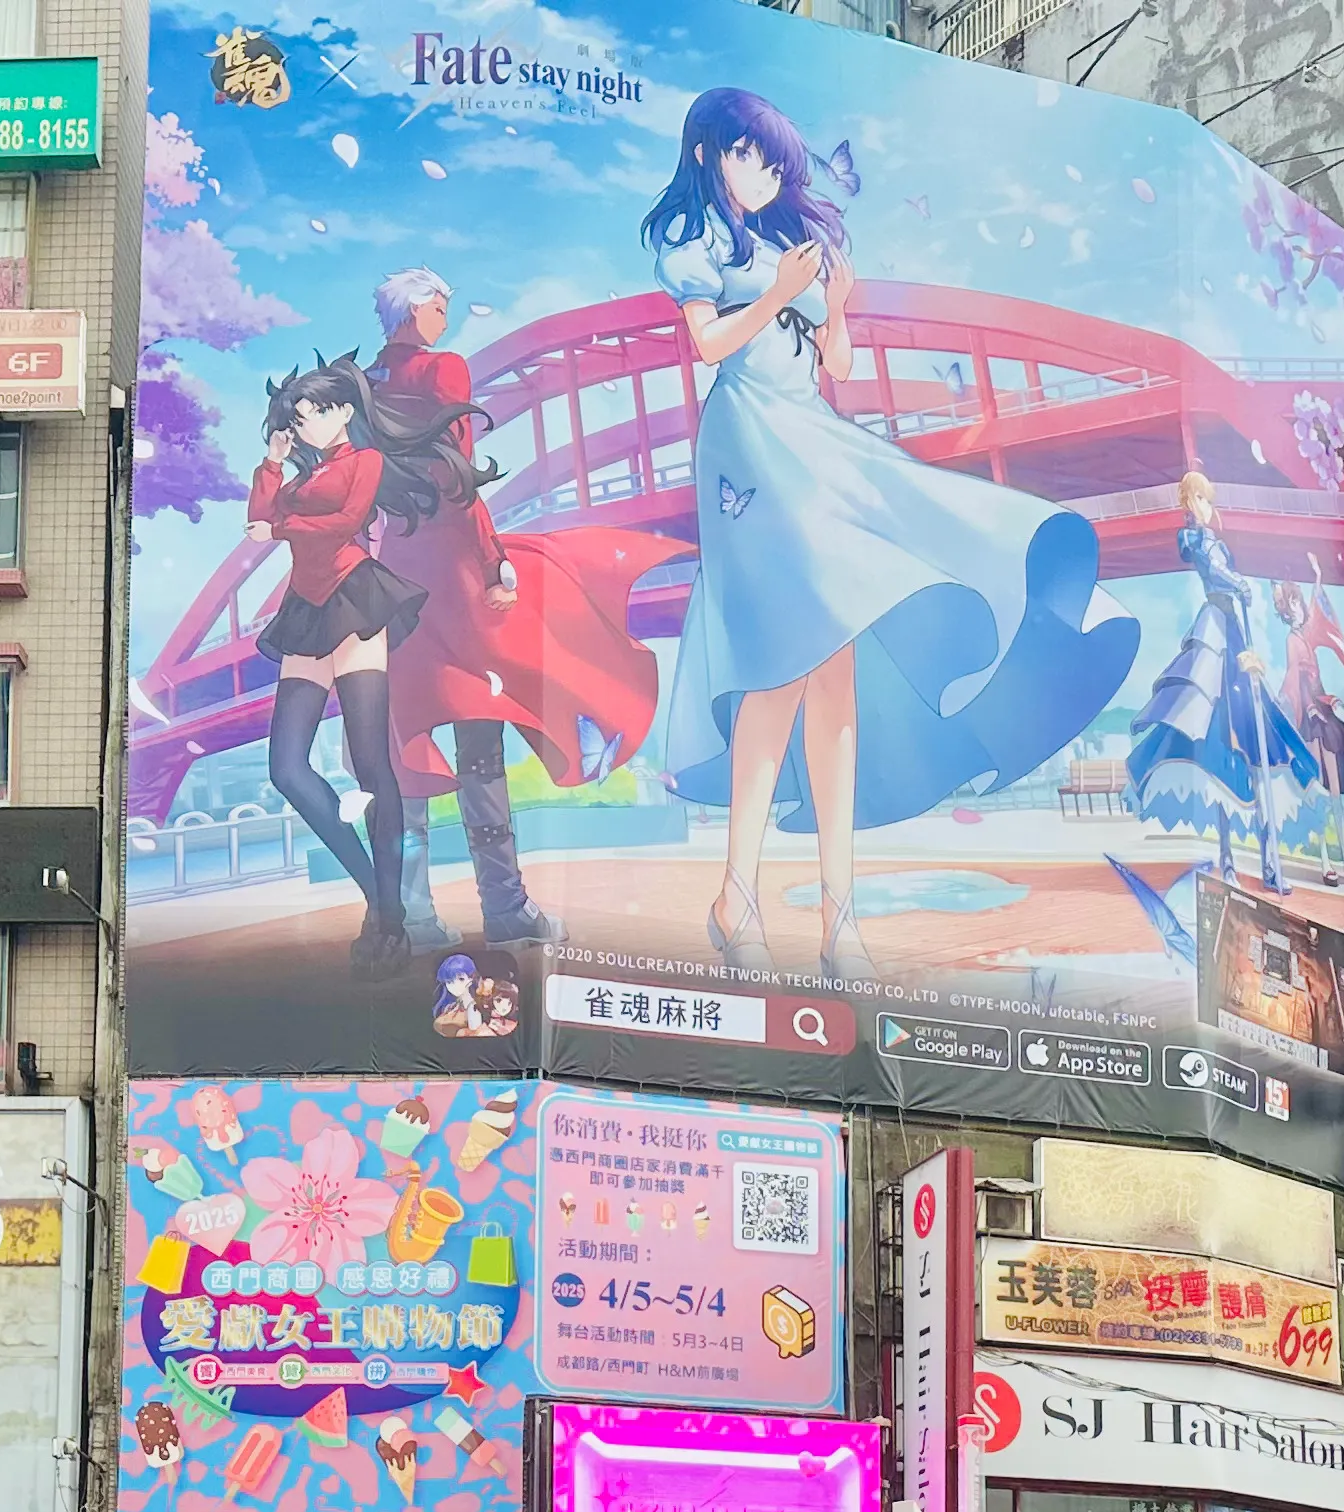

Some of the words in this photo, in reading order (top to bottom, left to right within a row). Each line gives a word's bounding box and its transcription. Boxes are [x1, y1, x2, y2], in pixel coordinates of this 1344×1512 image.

[411, 31, 513, 87] Fate
[518, 60, 571, 96] stay
[576, 64, 645, 105] night
[556, 102, 598, 120] Feel
[8, 352, 51, 373] 6F
[556, 944, 594, 964] 2020
[596, 951, 706, 978] SOULCREATOR
[708, 965, 782, 986] NETWORK
[784, 973, 882, 997] TECHNOLOGY
[584, 985, 724, 1033] 雀魂麻將
[914, 1037, 968, 1059] Google
[971, 1043, 1004, 1065] Play
[1057, 1052, 1095, 1076] App
[1096, 1056, 1144, 1078] Store
[1212, 1067, 1247, 1095] STEAM
[183, 1201, 243, 1237] 2025
[552, 1281, 587, 1300] 2025
[598, 1277, 727, 1318] 4/5~5/4
[996, 1258, 1098, 1311] 玉芙蓉
[1142, 1268, 1213, 1314] 按摩
[1217, 1280, 1268, 1321] 護膚
[1004, 1314, 1090, 1337] U-FLOWER
[1044, 1394, 1105, 1440] SJ
[1136, 1400, 1249, 1453] Hair
